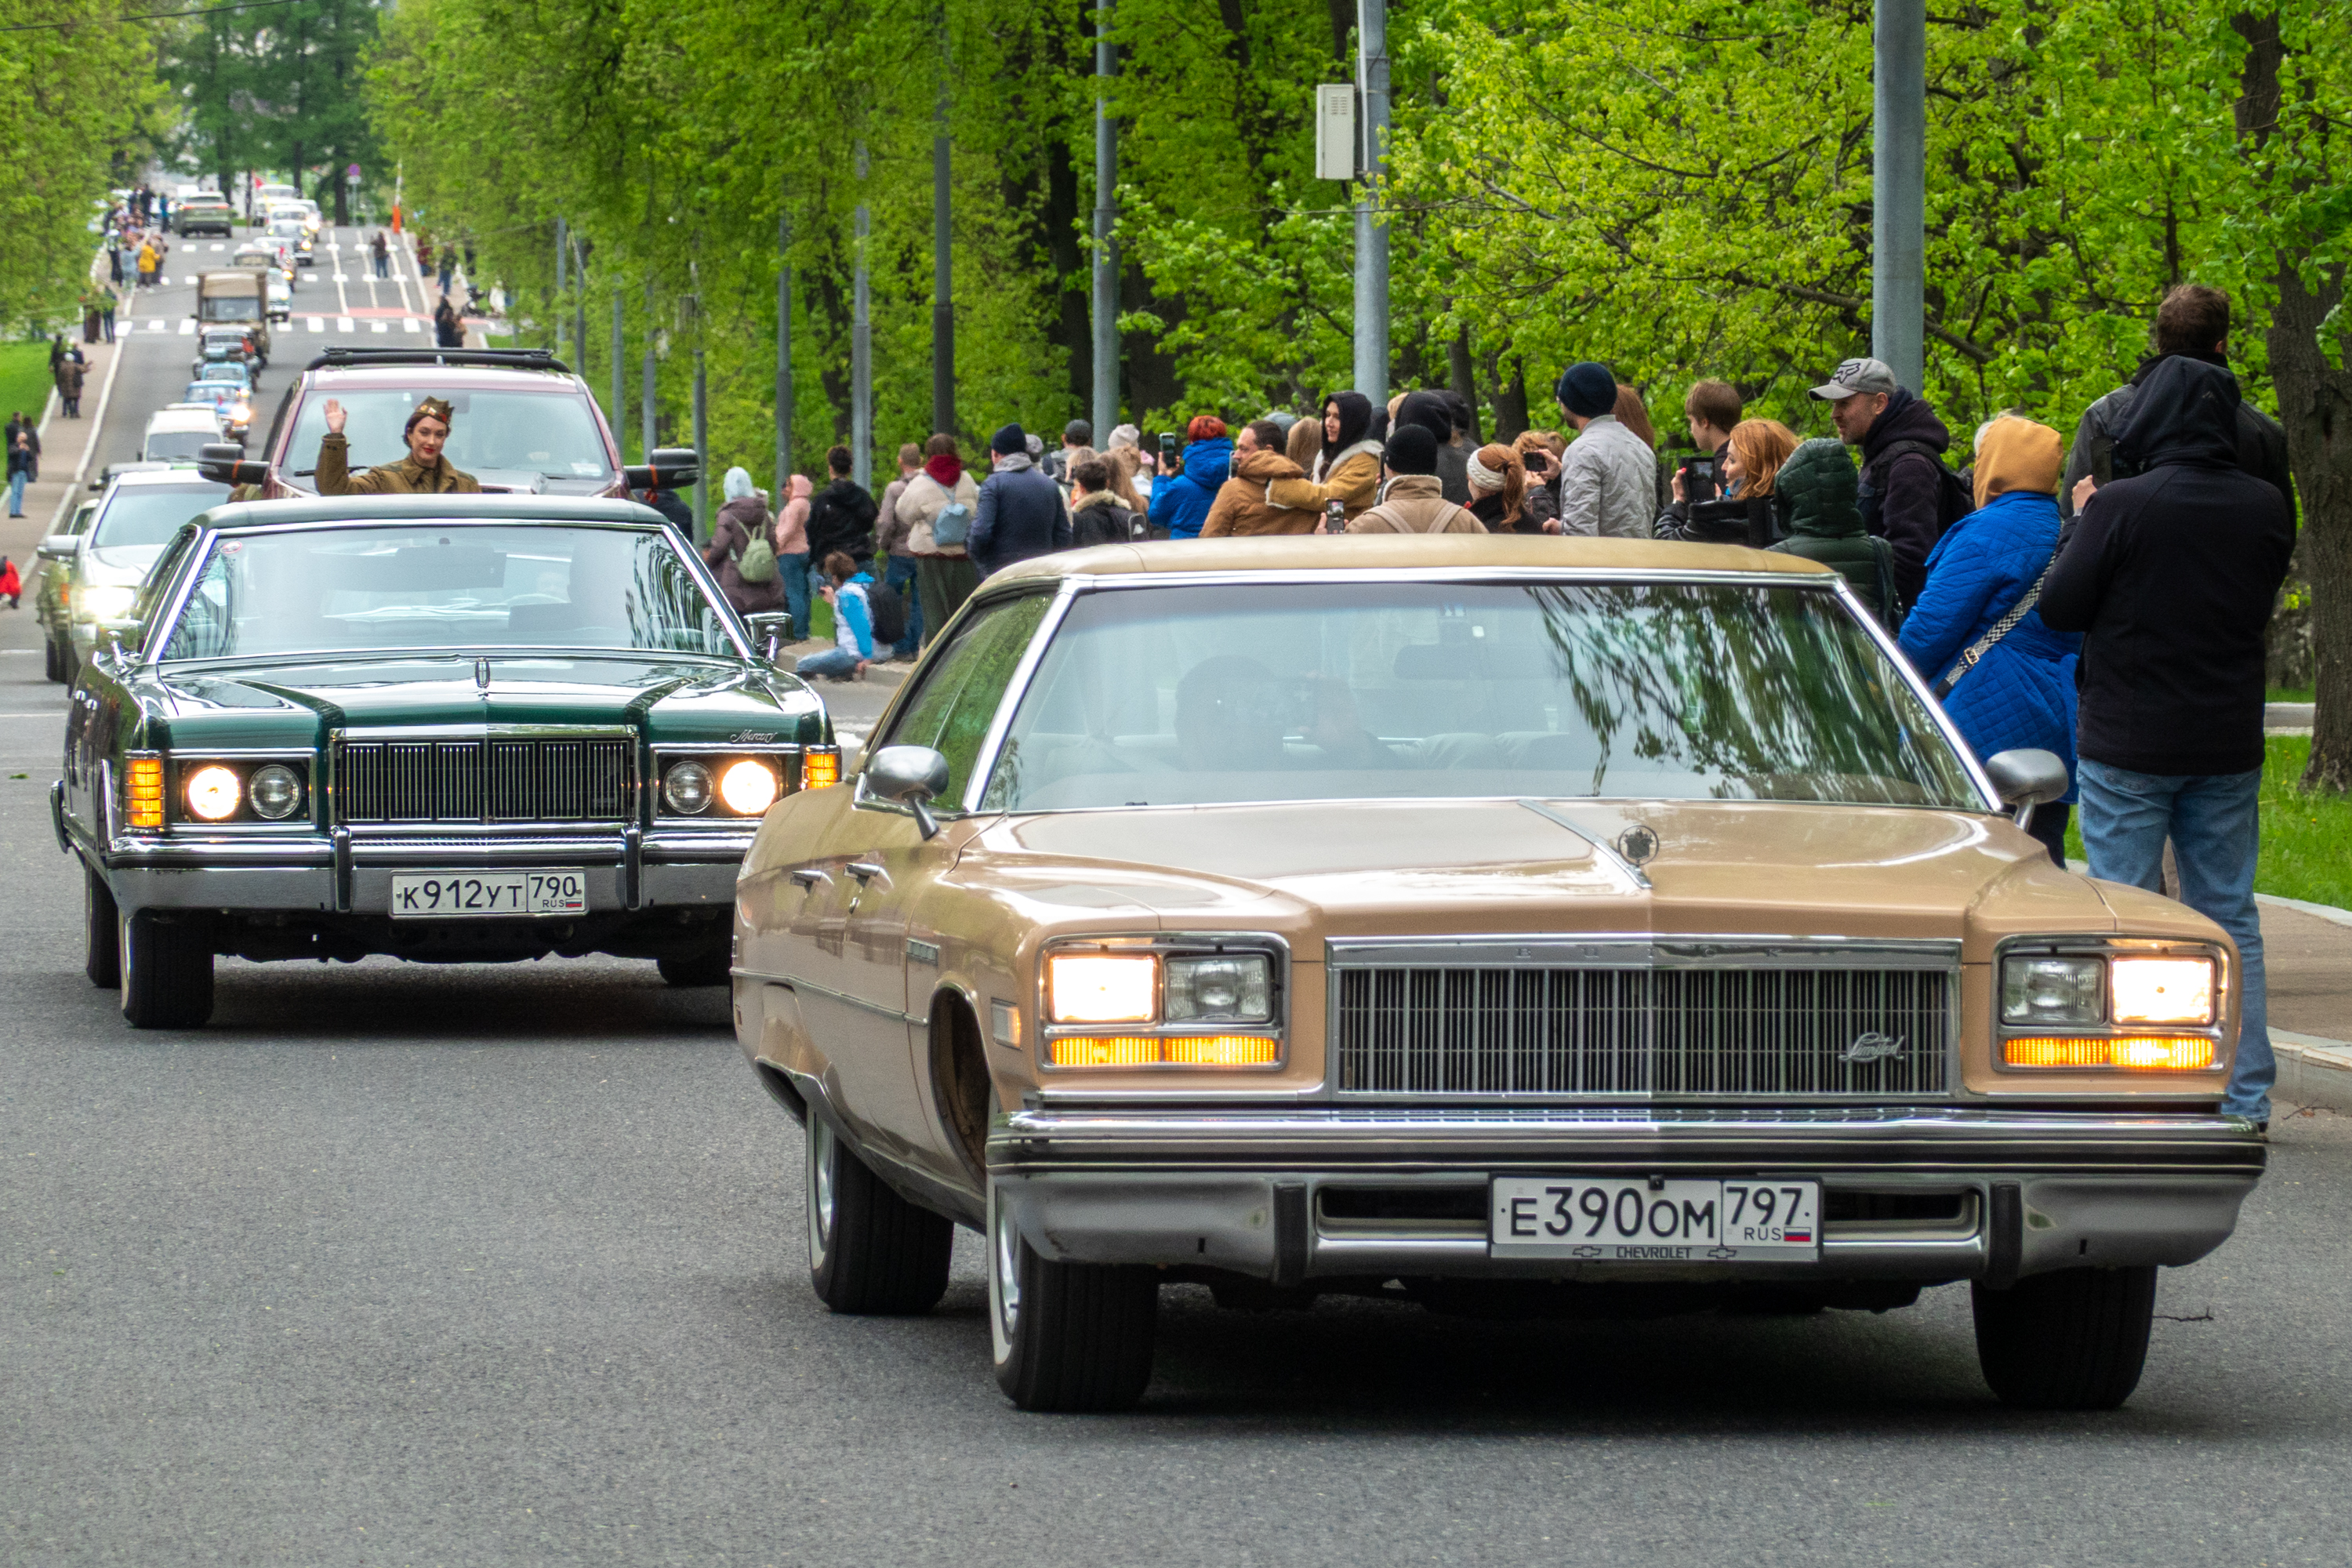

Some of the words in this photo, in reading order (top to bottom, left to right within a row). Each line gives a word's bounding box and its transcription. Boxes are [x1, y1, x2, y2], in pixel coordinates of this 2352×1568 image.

[730, 729, 778, 743] Mercury
[530, 876, 577, 898] 790
[543, 899, 564, 908] RUS
[1838, 1032, 1905, 1062] Limited
[1726, 1186, 1802, 1225] 797
[1744, 1227, 1781, 1240] RUS
[1616, 1246, 1693, 1259] CHEVROLET
